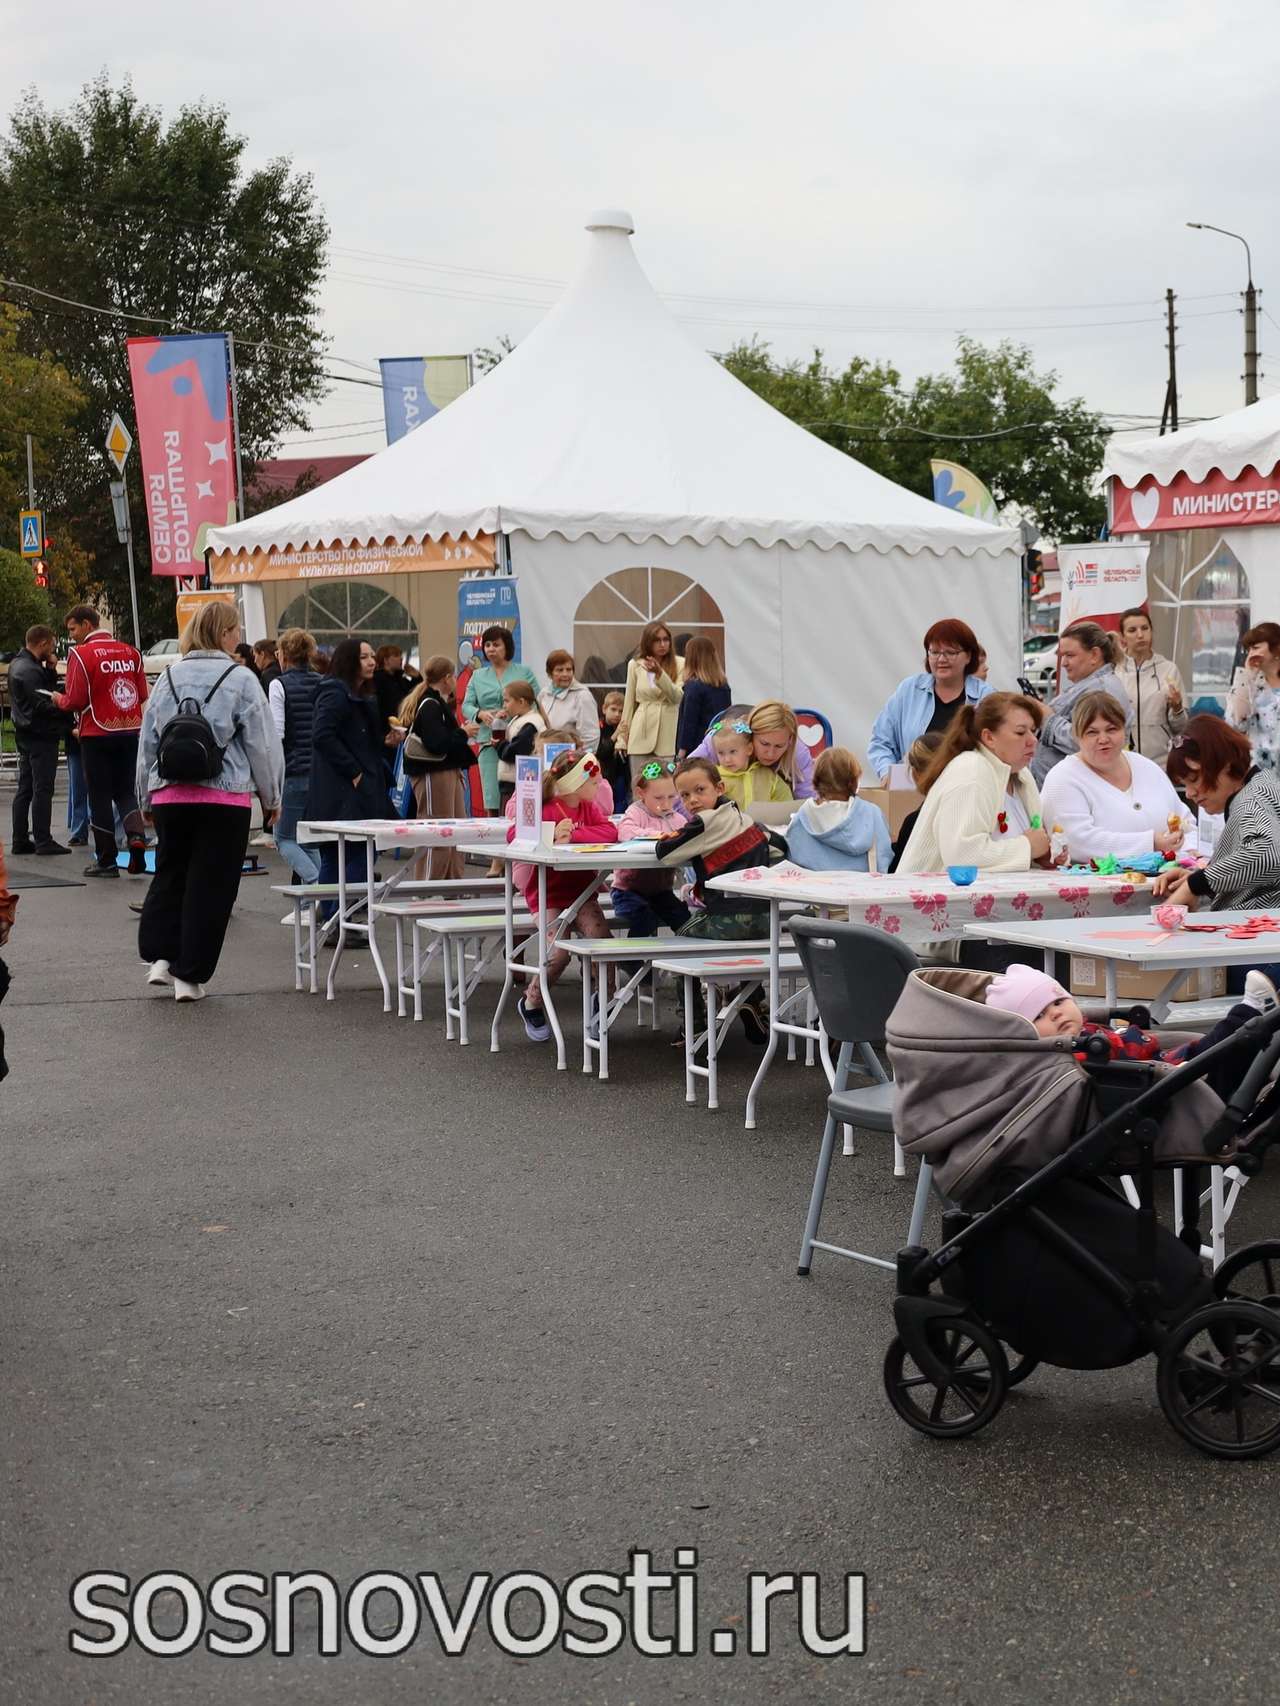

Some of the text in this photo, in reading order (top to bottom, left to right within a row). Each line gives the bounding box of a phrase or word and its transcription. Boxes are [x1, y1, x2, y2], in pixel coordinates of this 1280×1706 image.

[269, 544, 424, 567] МИНИСТЕРСТВО ПО ФИЗИЧЕСКОЙ
[299, 562, 344, 577] КУЛЬТУРЕ
[353, 560, 391, 574] СПОРТУ
[100, 659, 135, 674] СУДЬЯ
